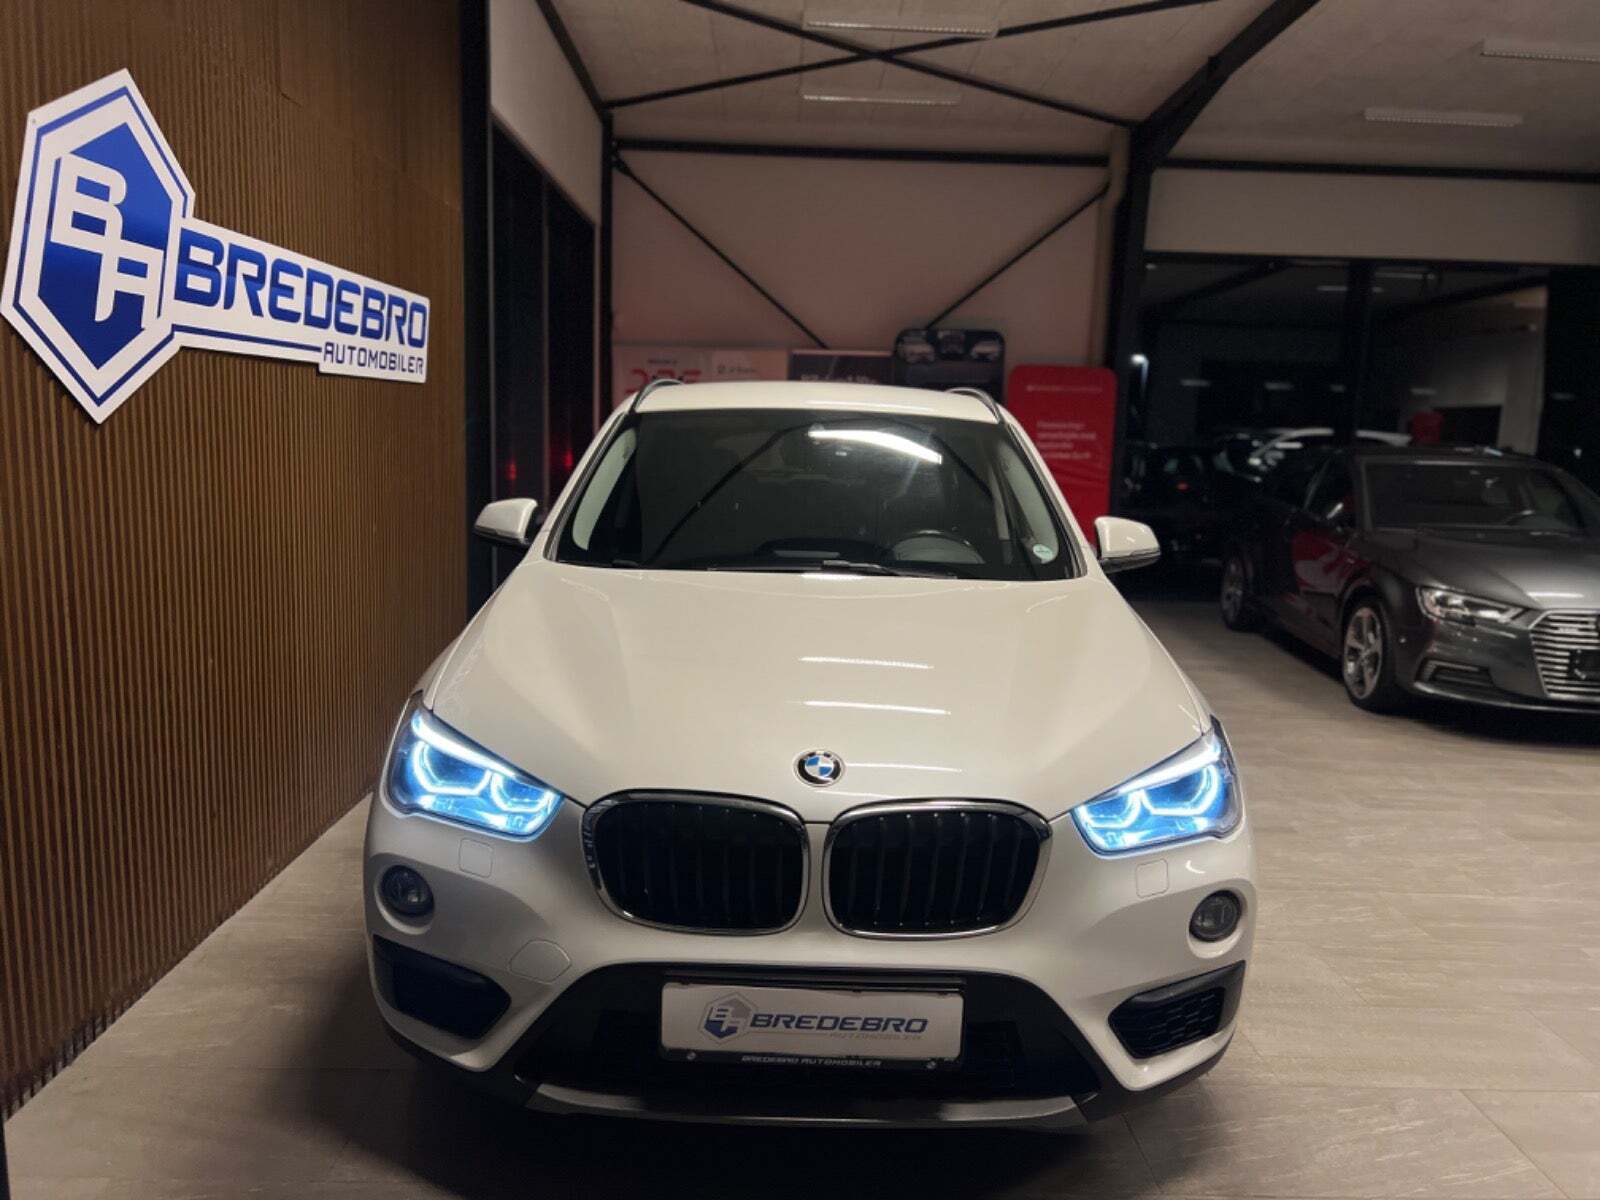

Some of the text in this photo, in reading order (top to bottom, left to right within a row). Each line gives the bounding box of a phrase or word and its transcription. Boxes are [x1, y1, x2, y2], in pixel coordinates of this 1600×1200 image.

[174, 227, 427, 349] BREDEBRO
[323, 341, 423, 375] AUTOMOBILER
[750, 1013, 929, 1034] BREDEBRO
[741, 1055, 881, 1067] BREDEBRO AUTOMOBILER
